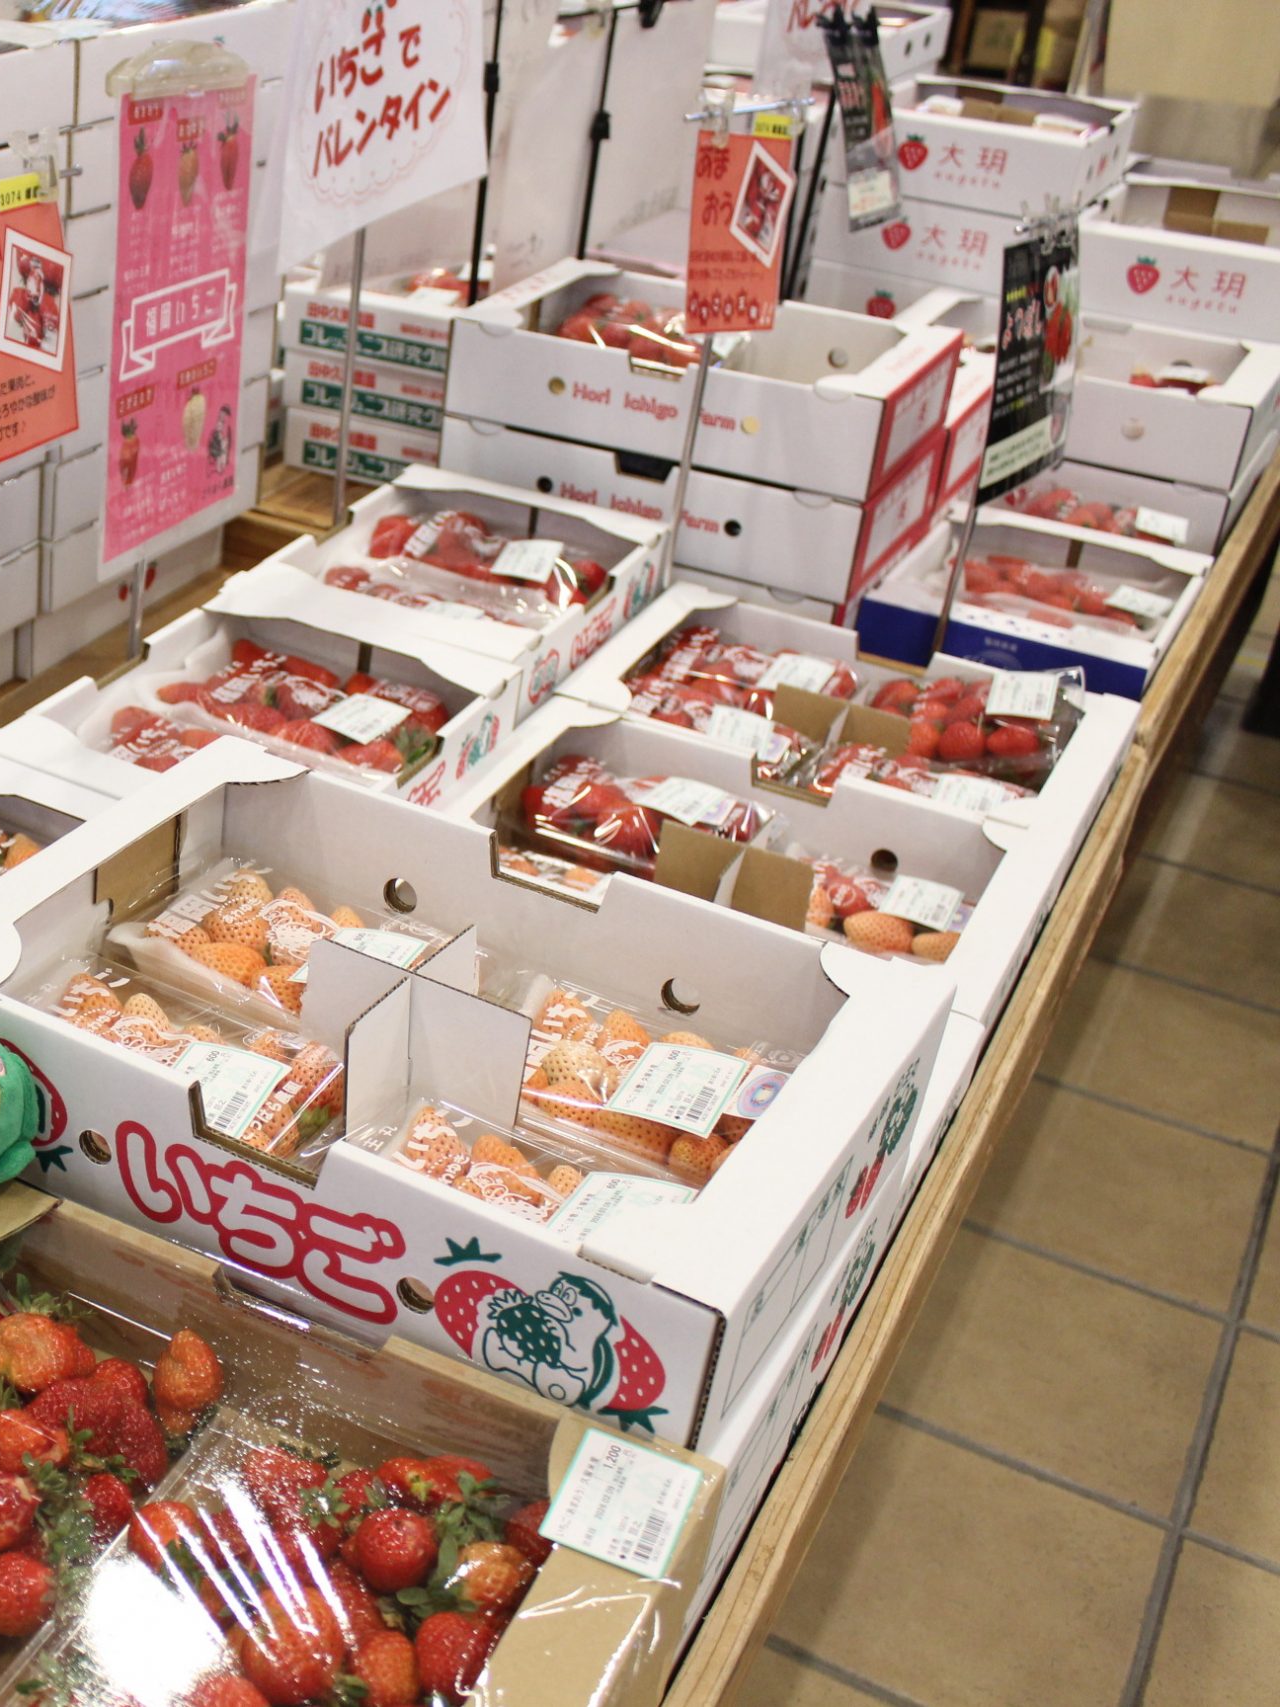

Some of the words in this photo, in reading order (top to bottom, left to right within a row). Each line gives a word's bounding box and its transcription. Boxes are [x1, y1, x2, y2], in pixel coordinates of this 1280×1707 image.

[315, 24, 421, 114] いちごで
[313, 78, 451, 177] バレンタイン
[115, 1120, 406, 1325] いちご
